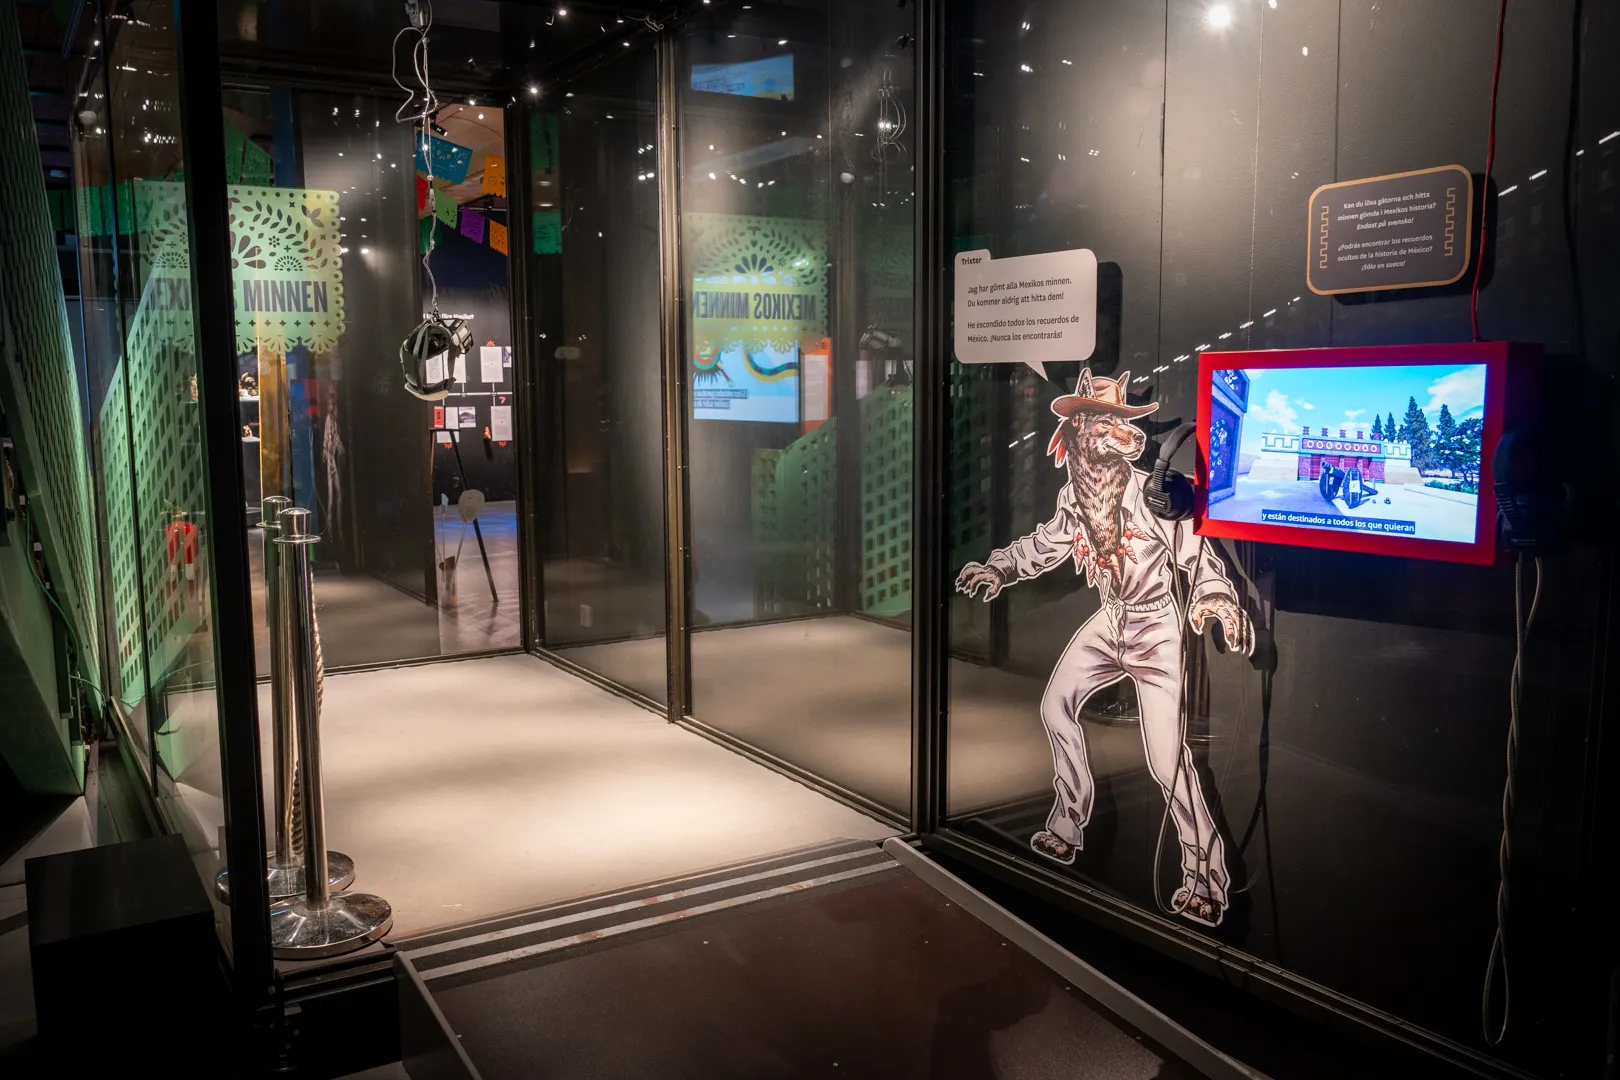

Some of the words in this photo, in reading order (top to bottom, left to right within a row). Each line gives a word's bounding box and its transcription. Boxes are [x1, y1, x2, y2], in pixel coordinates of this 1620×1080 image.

[1365, 198, 1376, 206] lösa
[1378, 196, 1401, 205] gåtorna
[1338, 213, 1358, 221] minnen
[1360, 211, 1379, 219] gömda
[1384, 206, 1408, 215] Mexikos
[1409, 203, 1436, 212] historia?
[1357, 222, 1377, 230] Endast
[1378, 221, 1386, 229] på
[1387, 217, 1414, 226] svenska!
[1338, 242, 1360, 251] ¿Podrás
[1362, 239, 1390, 247] encontrar
[1402, 234, 1433, 243] recuerdos
[1368, 251, 1374, 259] la
[1375, 249, 1397, 258] historia
[1408, 246, 1433, 254] México?
[962, 257, 982, 265] Trixter
[1361, 263, 1376, 271] ¡Sólo
[1386, 260, 1406, 268] sueco!
[968, 286, 977, 294] Jag
[990, 283, 1005, 293] gömt
[1019, 279, 1044, 288] Mexikos
[1045, 278, 1071, 286] minnen.
[243, 279, 328, 313] MINNEN
[977, 298, 1000, 306] kommer
[1002, 295, 1019, 305] aldrig
[1031, 293, 1046, 302] hitta
[1048, 292, 1064, 301] dem!
[977, 319, 1006, 328] escondido
[1008, 318, 1025, 326] todos
[1037, 315, 1069, 324] recuerdos
[968, 334, 988, 342] México.
[990, 334, 1011, 342] ¡Nunca
[1023, 331, 1062, 339] encontrarás!
[1262, 512, 1266, 522] y
[1268, 511, 1286, 522] están
[1288, 513, 1325, 525] destinados
[1333, 518, 1354, 526] todos
[1355, 519, 1366, 528] los
[1368, 522, 1382, 531] que
[1384, 522, 1415, 532] quieran
